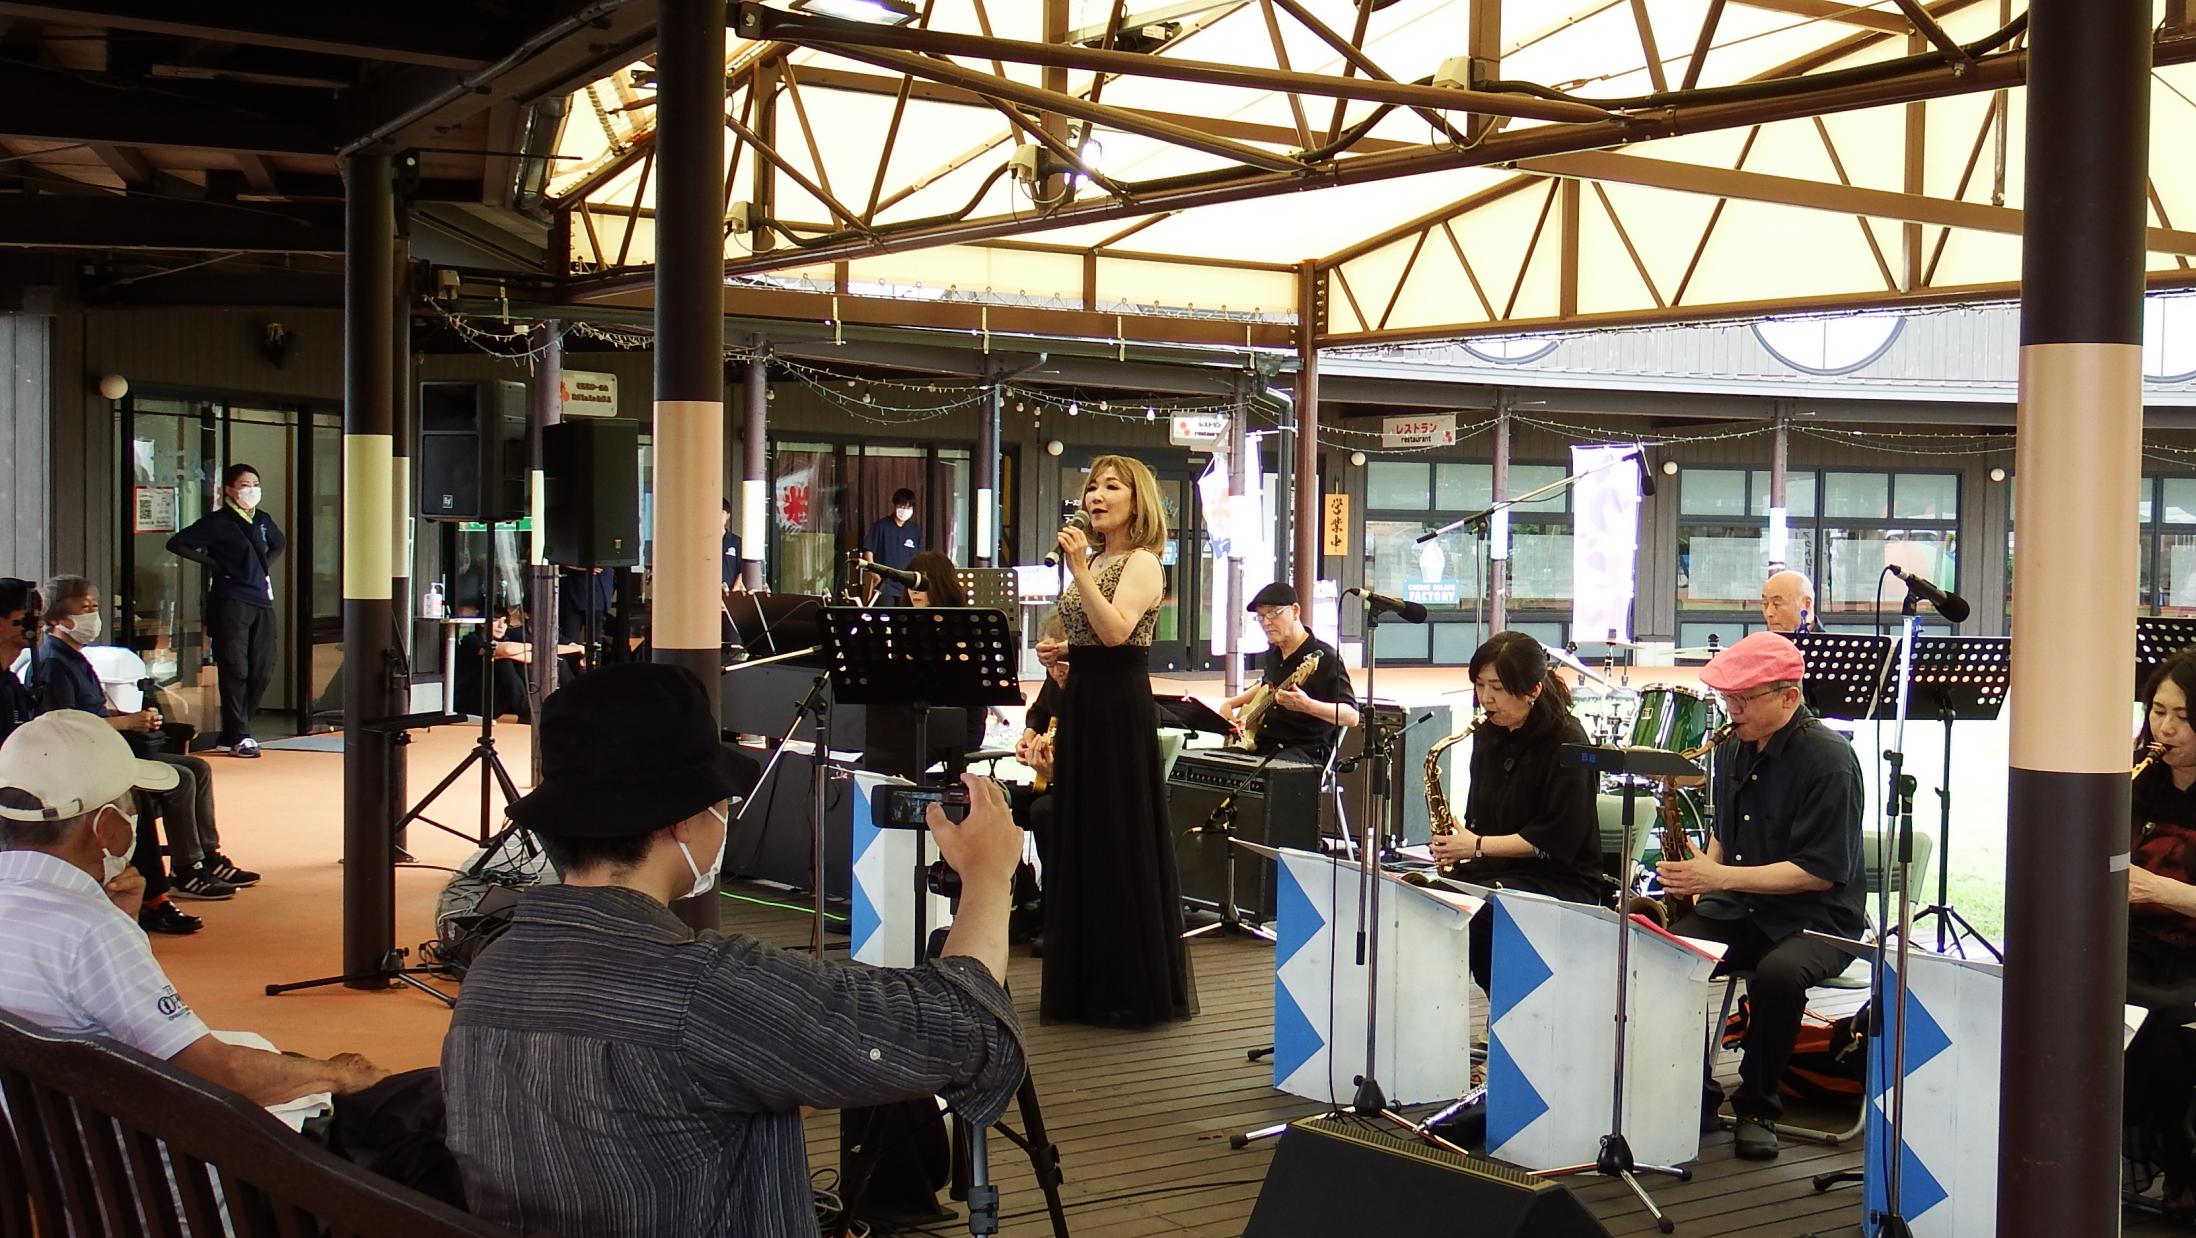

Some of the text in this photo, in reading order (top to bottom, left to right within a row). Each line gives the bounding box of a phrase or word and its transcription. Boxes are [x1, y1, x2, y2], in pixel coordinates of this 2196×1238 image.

[1396, 422, 1437, 434] レストラン
[1401, 435, 1432, 443] restaurant
[1330, 498, 1344, 552] 営業中
[1408, 591, 1456, 602] FACTORY
